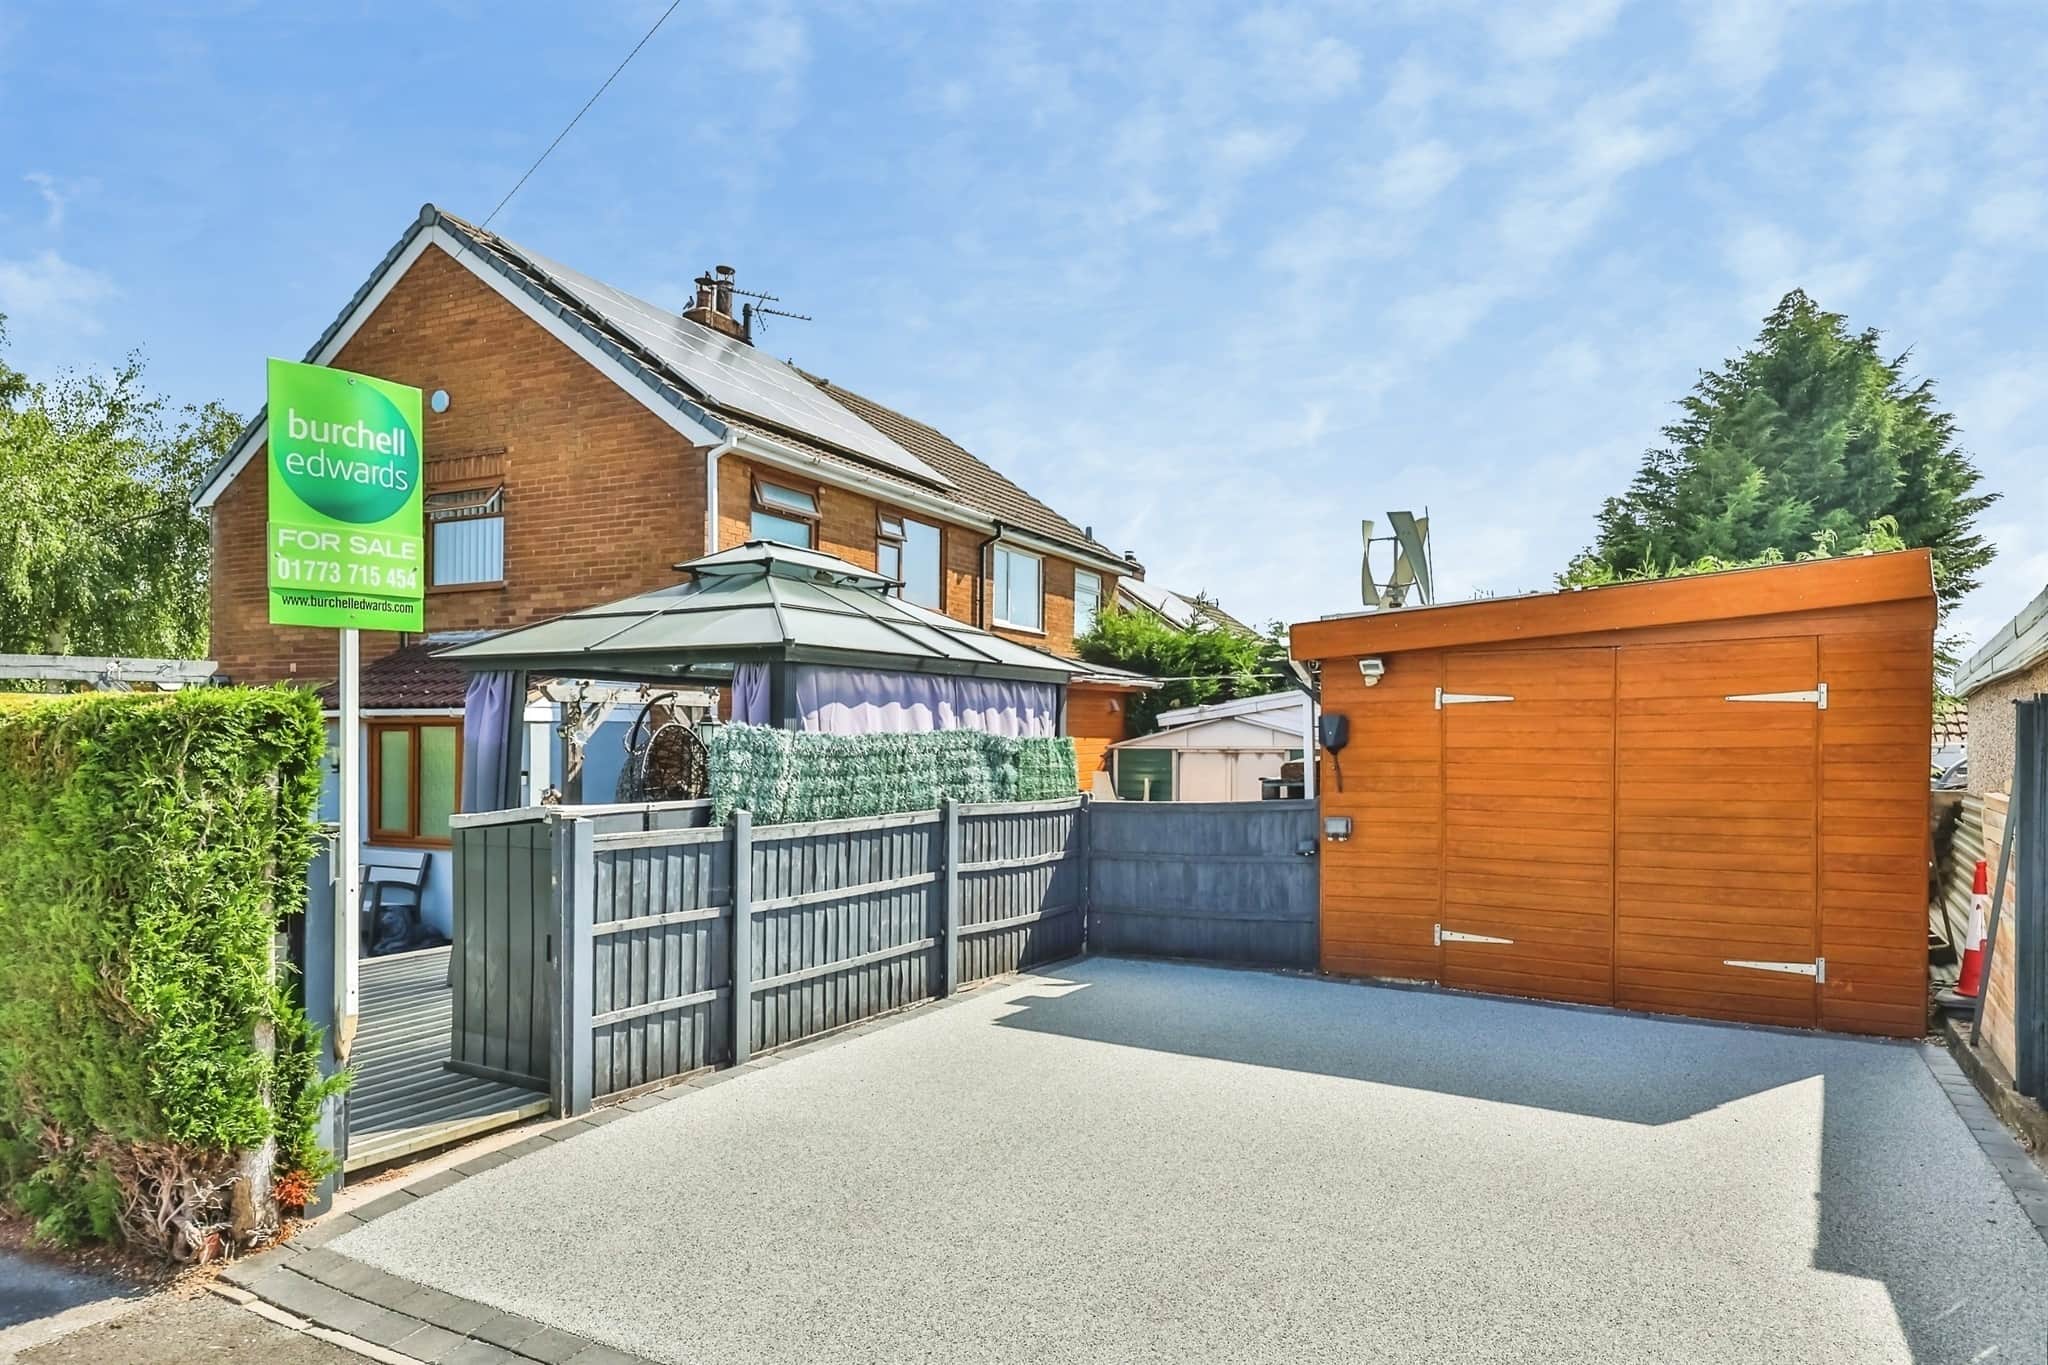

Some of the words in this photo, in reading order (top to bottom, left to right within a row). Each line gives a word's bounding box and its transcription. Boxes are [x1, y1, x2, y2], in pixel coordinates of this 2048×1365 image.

[288, 408, 406, 457] burchell
[286, 448, 409, 491] edwards
[279, 529, 341, 552] FOR
[350, 535, 417, 561] SALE
[278, 557, 341, 584] 01773
[348, 564, 381, 586] 715
[386, 568, 417, 590] 454
[282, 595, 414, 614] www.burchelledwards.com
